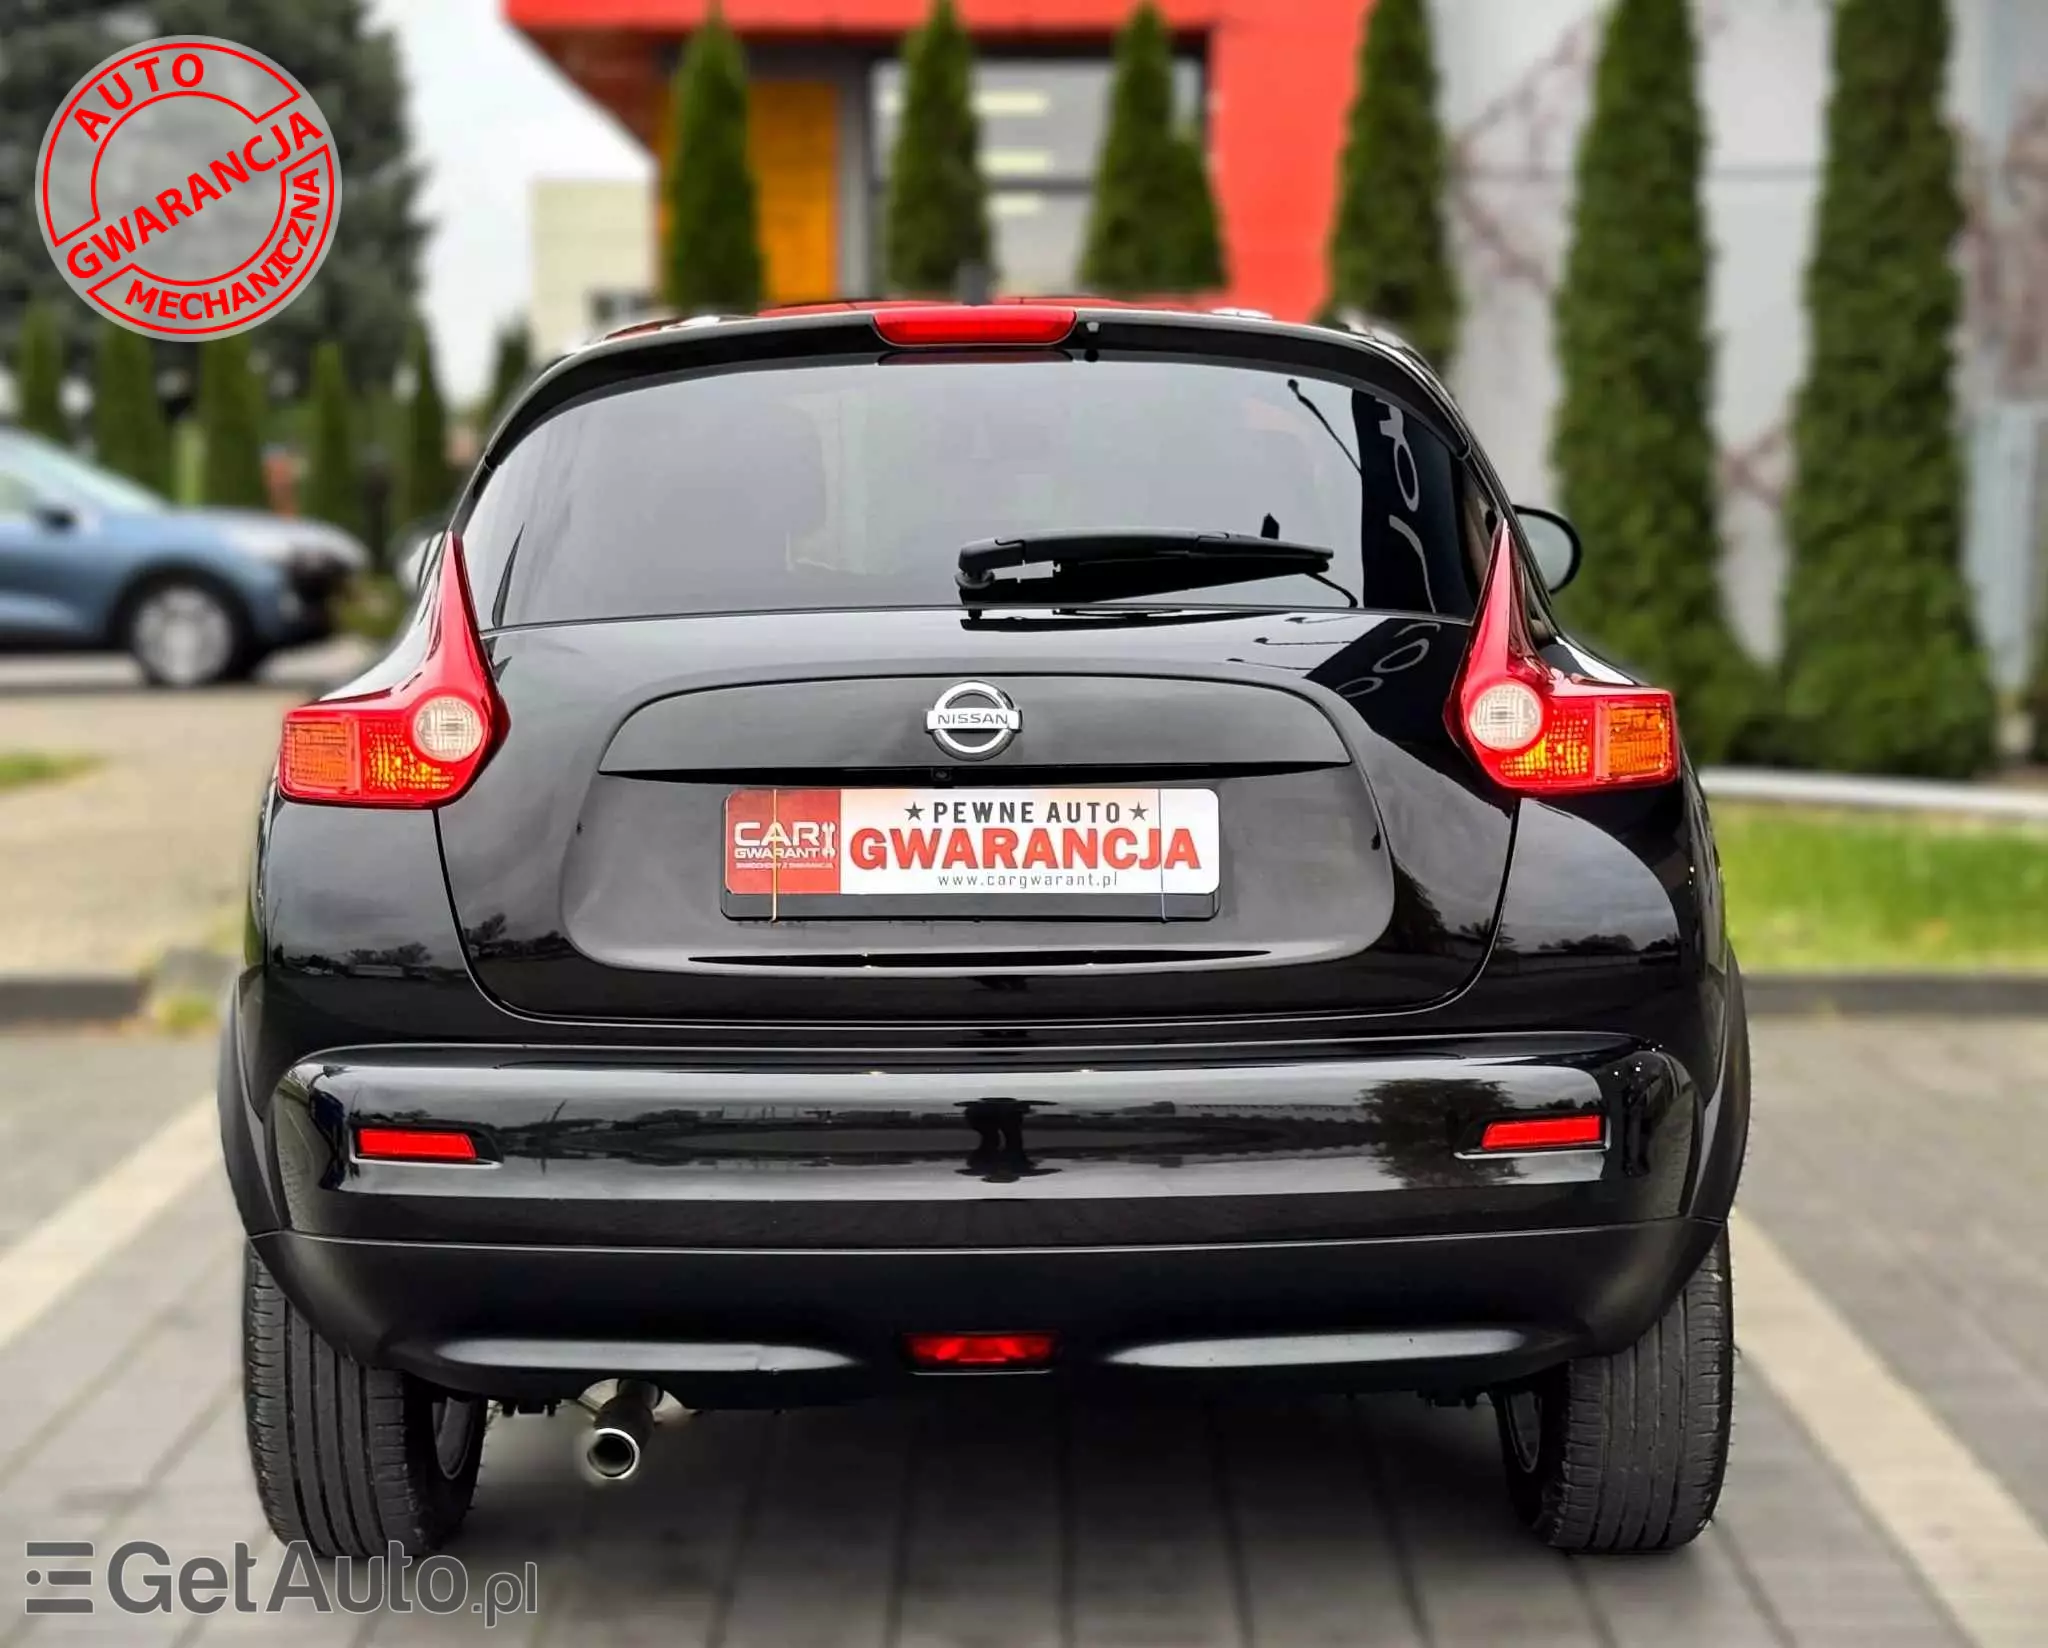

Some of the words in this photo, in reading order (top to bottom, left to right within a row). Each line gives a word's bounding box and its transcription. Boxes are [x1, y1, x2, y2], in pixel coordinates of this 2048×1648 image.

[937, 713, 1008, 725] NISSAN
[933, 802, 1034, 823] PEWNE
[1046, 802, 1120, 823] AUTO
[735, 822, 820, 846] CAR
[735, 847, 820, 859] GWARANT
[850, 828, 1201, 870] GWARANCJA
[938, 872, 1118, 889] www.cargwarant.pl
